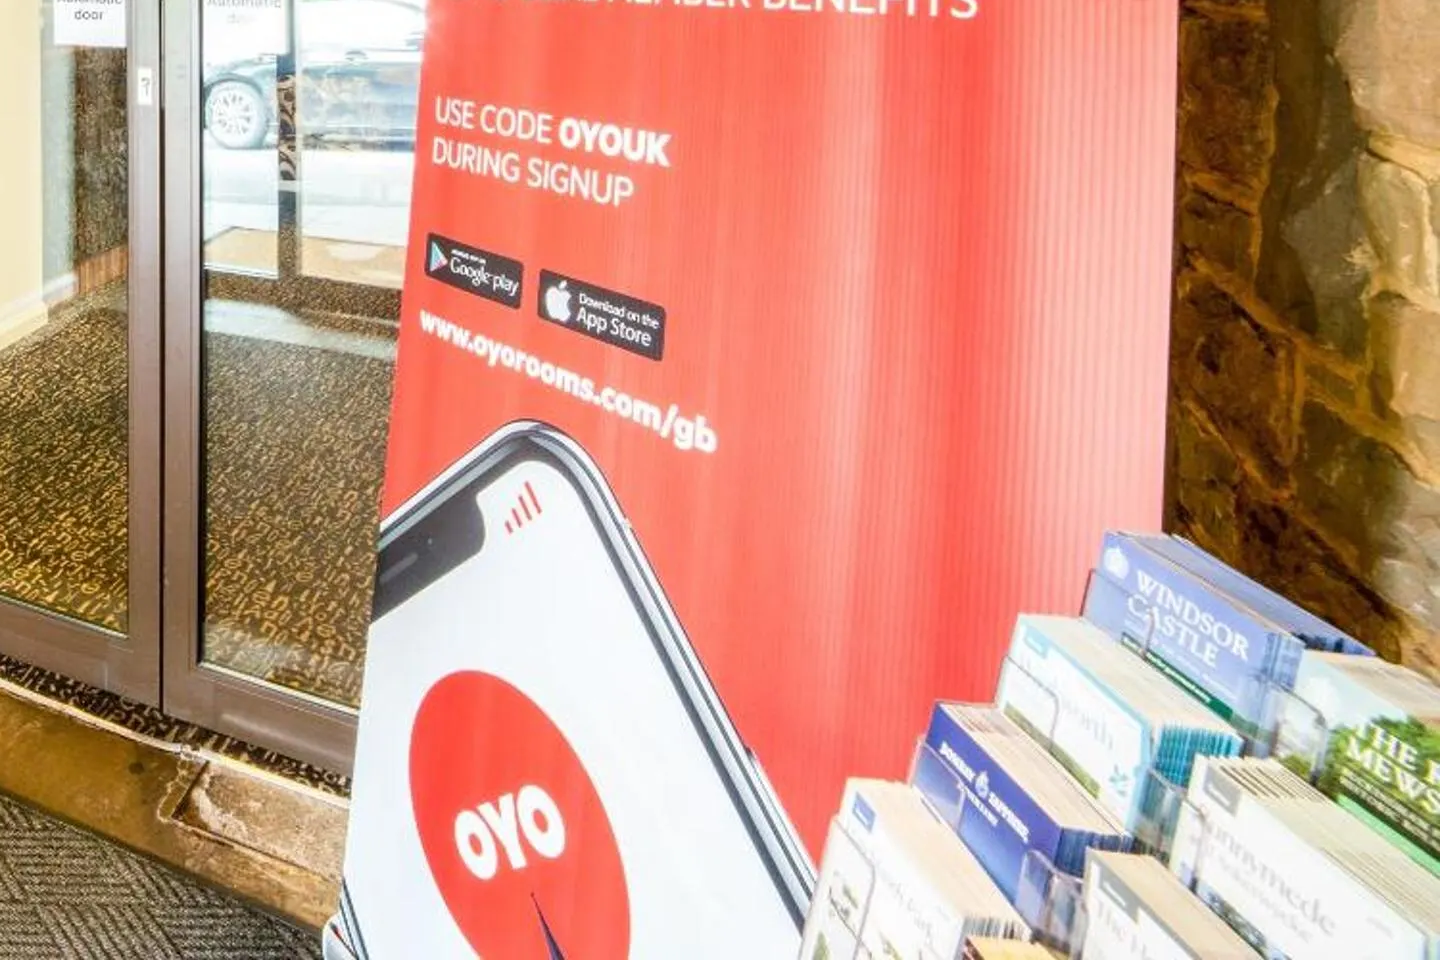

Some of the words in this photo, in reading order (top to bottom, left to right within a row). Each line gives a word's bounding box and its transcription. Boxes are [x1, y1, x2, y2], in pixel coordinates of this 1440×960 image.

[74, 7, 104, 21] door
[435, 96, 475, 129] USE
[480, 104, 552, 144] CODE
[559, 117, 672, 167] OYOUK
[432, 137, 521, 183] DURING
[527, 159, 634, 207] SIGNUP
[450, 256, 489, 287] Google
[492, 273, 520, 297] play
[579, 292, 625, 318] Download
[627, 310, 641, 323] on
[641, 314, 660, 330] the
[576, 306, 608, 335] App
[610, 317, 653, 347] Store
[418, 308, 718, 453] www.oyorooms.com/gb
[1126, 593, 1221, 669] CASTLE
[1136, 568, 1251, 663] WINDSOR
[454, 784, 566, 880] OYO
